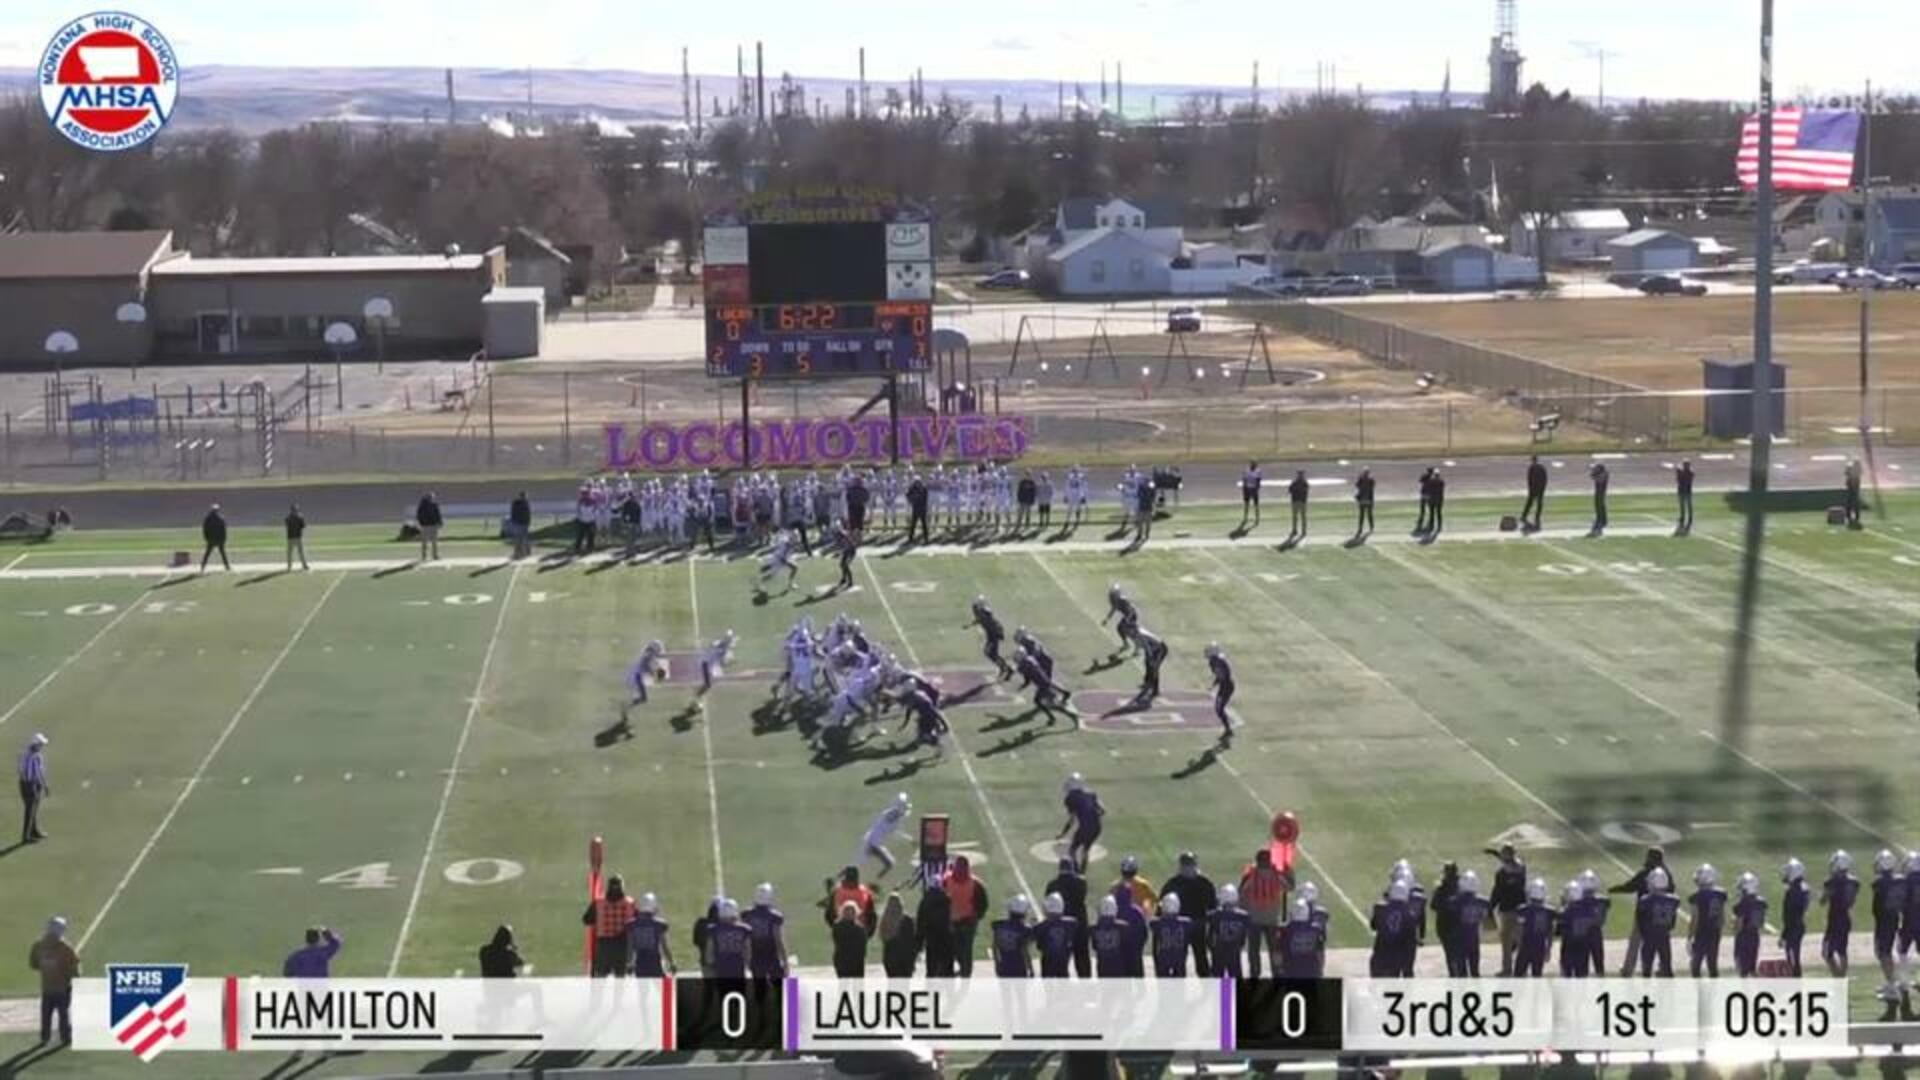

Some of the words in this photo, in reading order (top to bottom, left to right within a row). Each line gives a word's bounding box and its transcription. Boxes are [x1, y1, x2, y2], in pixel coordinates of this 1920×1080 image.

[780, 305, 835, 330] 6:22
[913, 317, 925, 336] 0
[726, 321, 739, 341] 0
[603, 417, 1030, 471] LOCOMOTIVES
